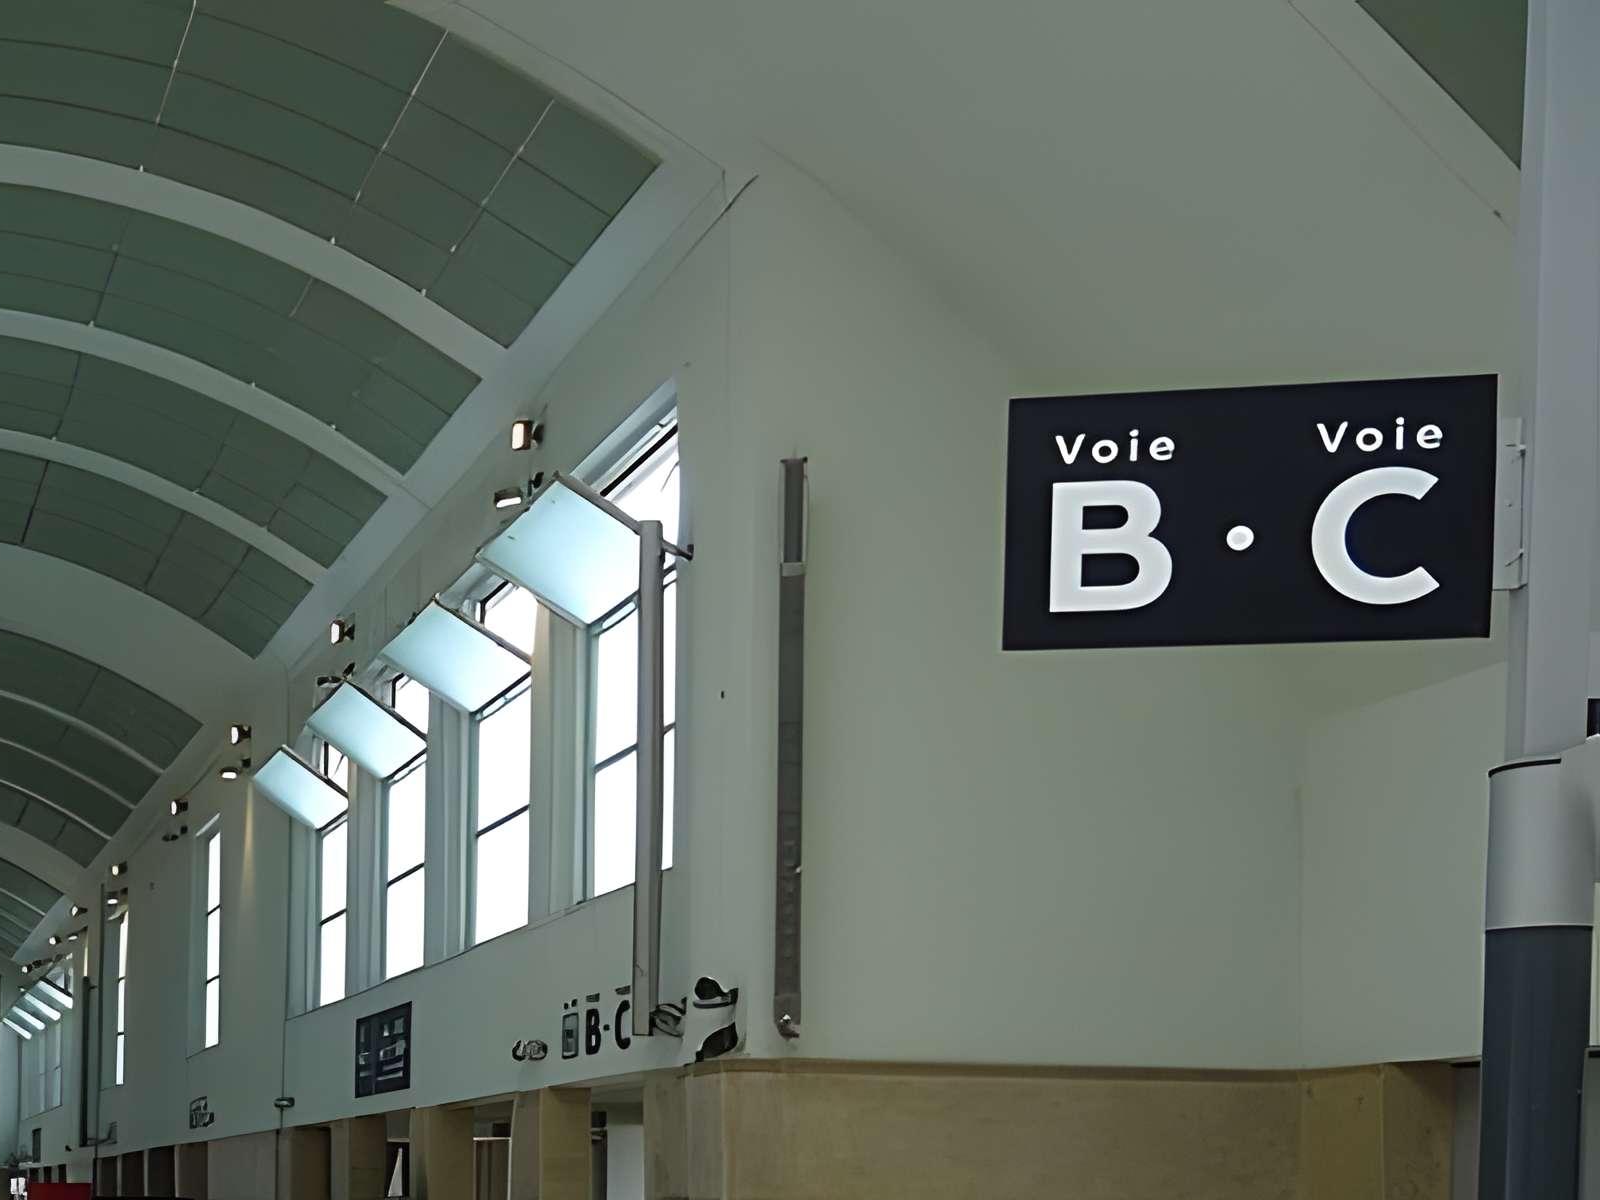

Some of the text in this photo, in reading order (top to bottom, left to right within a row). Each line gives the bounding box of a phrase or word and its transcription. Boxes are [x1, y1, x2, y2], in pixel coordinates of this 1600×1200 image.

[1055, 417, 1444, 465] Voie Voie
[1049, 466, 1440, 613] B C
[586, 1000, 631, 1055] B C
